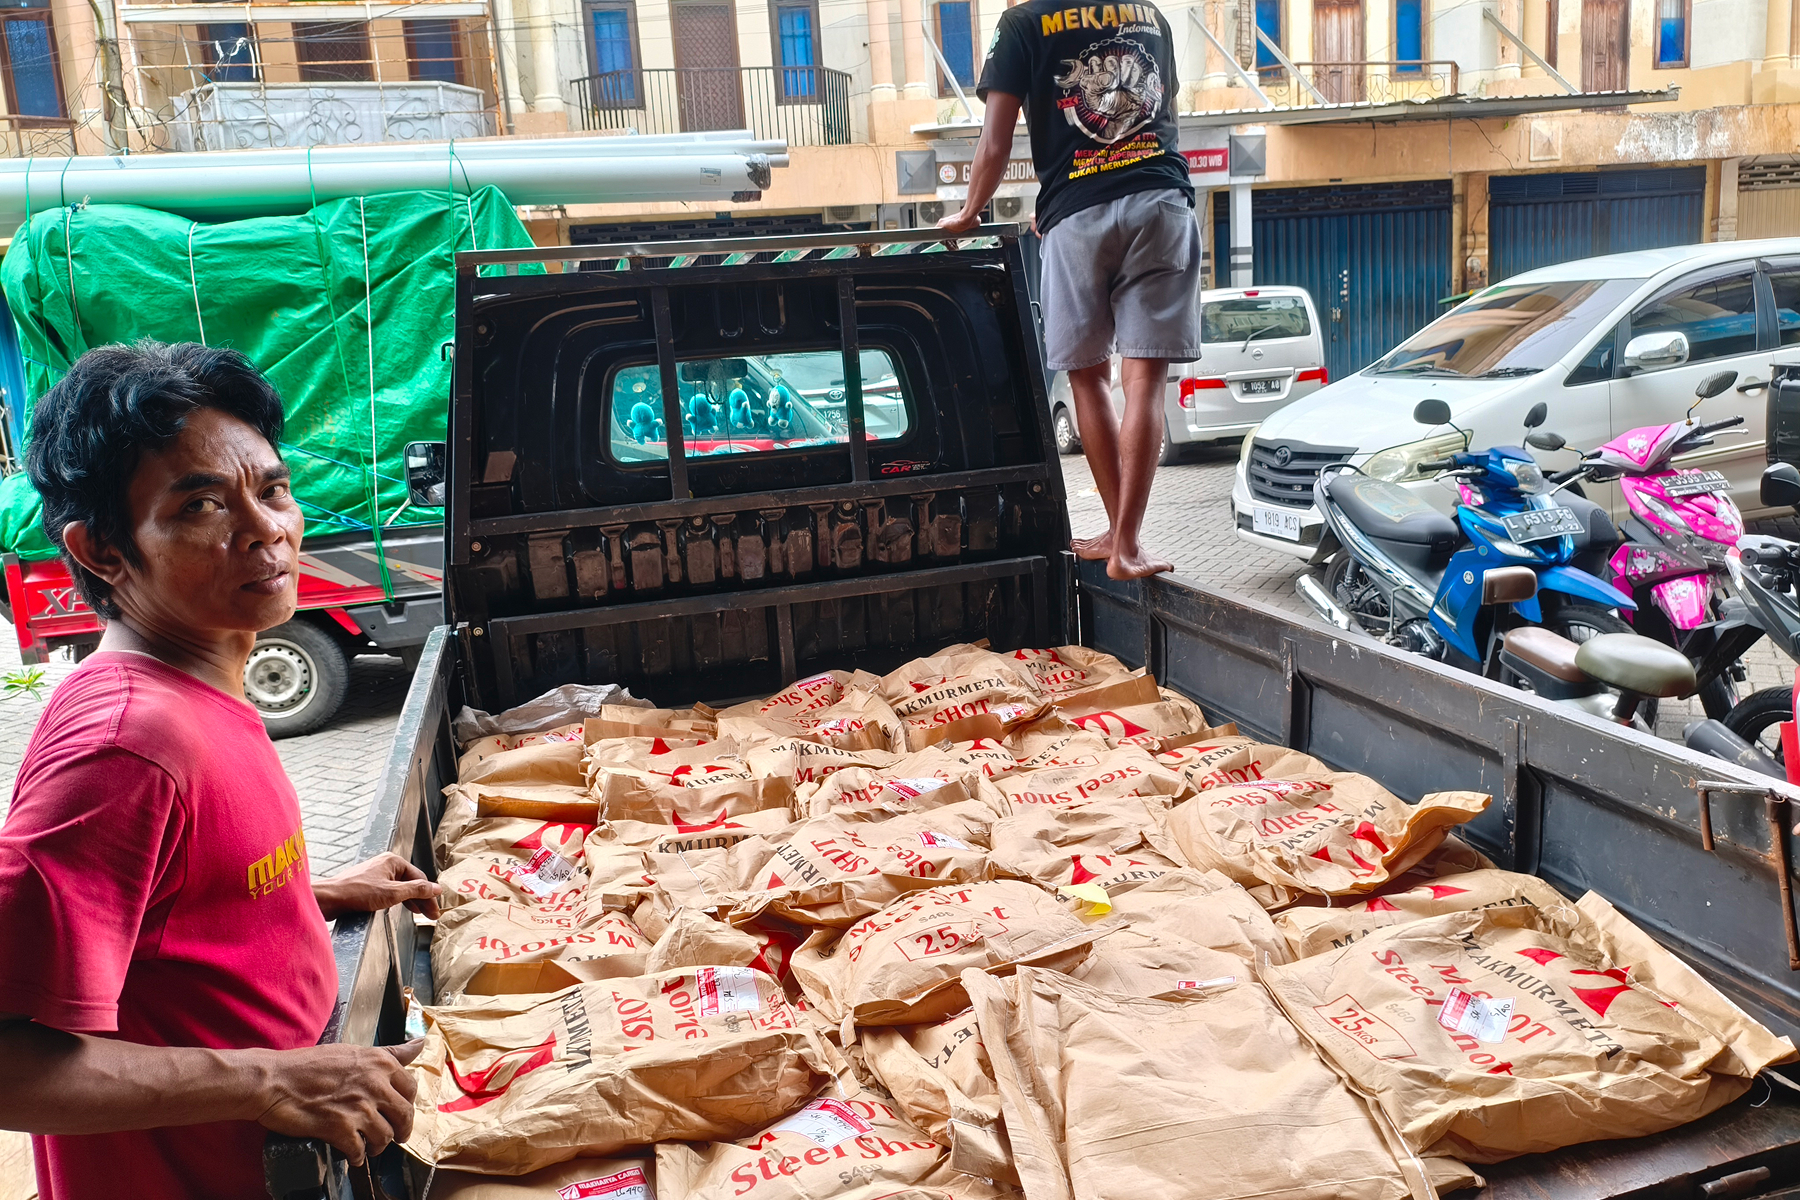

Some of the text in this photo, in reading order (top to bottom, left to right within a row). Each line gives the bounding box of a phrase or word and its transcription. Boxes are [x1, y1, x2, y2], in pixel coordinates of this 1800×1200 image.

[1208, 155, 1222, 167] WIB
[1069, 166, 1098, 180] BUKAN
[1242, 382, 1248, 391] L
[1506, 517, 1519, 530] L
[1012, 765, 1143, 806] Steel Shot
[1201, 760, 1265, 791] SHOT
[250, 868, 294, 900] YOUR
[1456, 931, 1625, 1062] MAKMURMETA
[617, 1169, 641, 1181] CARGO
[729, 1145, 849, 1197] Steel
